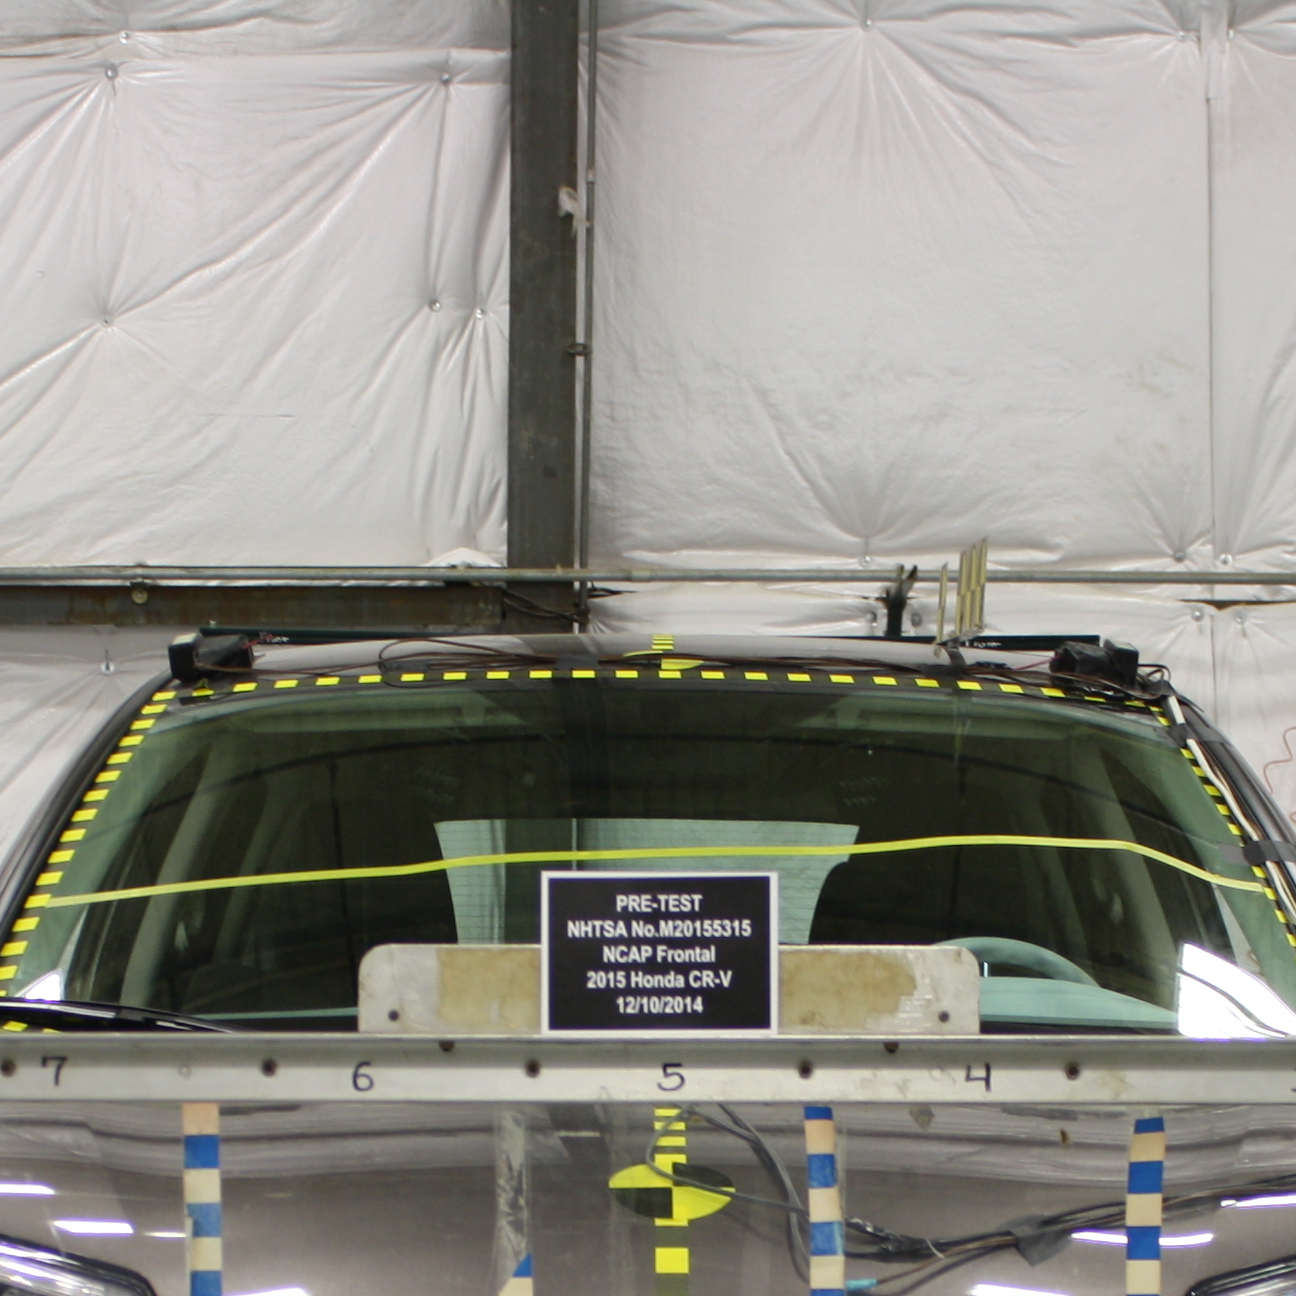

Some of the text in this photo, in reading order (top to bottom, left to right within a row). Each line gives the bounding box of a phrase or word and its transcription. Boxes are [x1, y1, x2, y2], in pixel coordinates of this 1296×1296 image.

[616, 894, 703, 912] PRE-TEST
[567, 919, 629, 938] NHTSA
[602, 945, 716, 963] NCAP Frontal
[586, 970, 733, 988] 2015 Honda CR-V
[616, 995, 704, 1014] 12/10/2014
[41, 1056, 69, 1087] 7
[352, 1062, 374, 1092] 6
[657, 1063, 685, 1093] 5
[965, 1063, 992, 1092] 4
